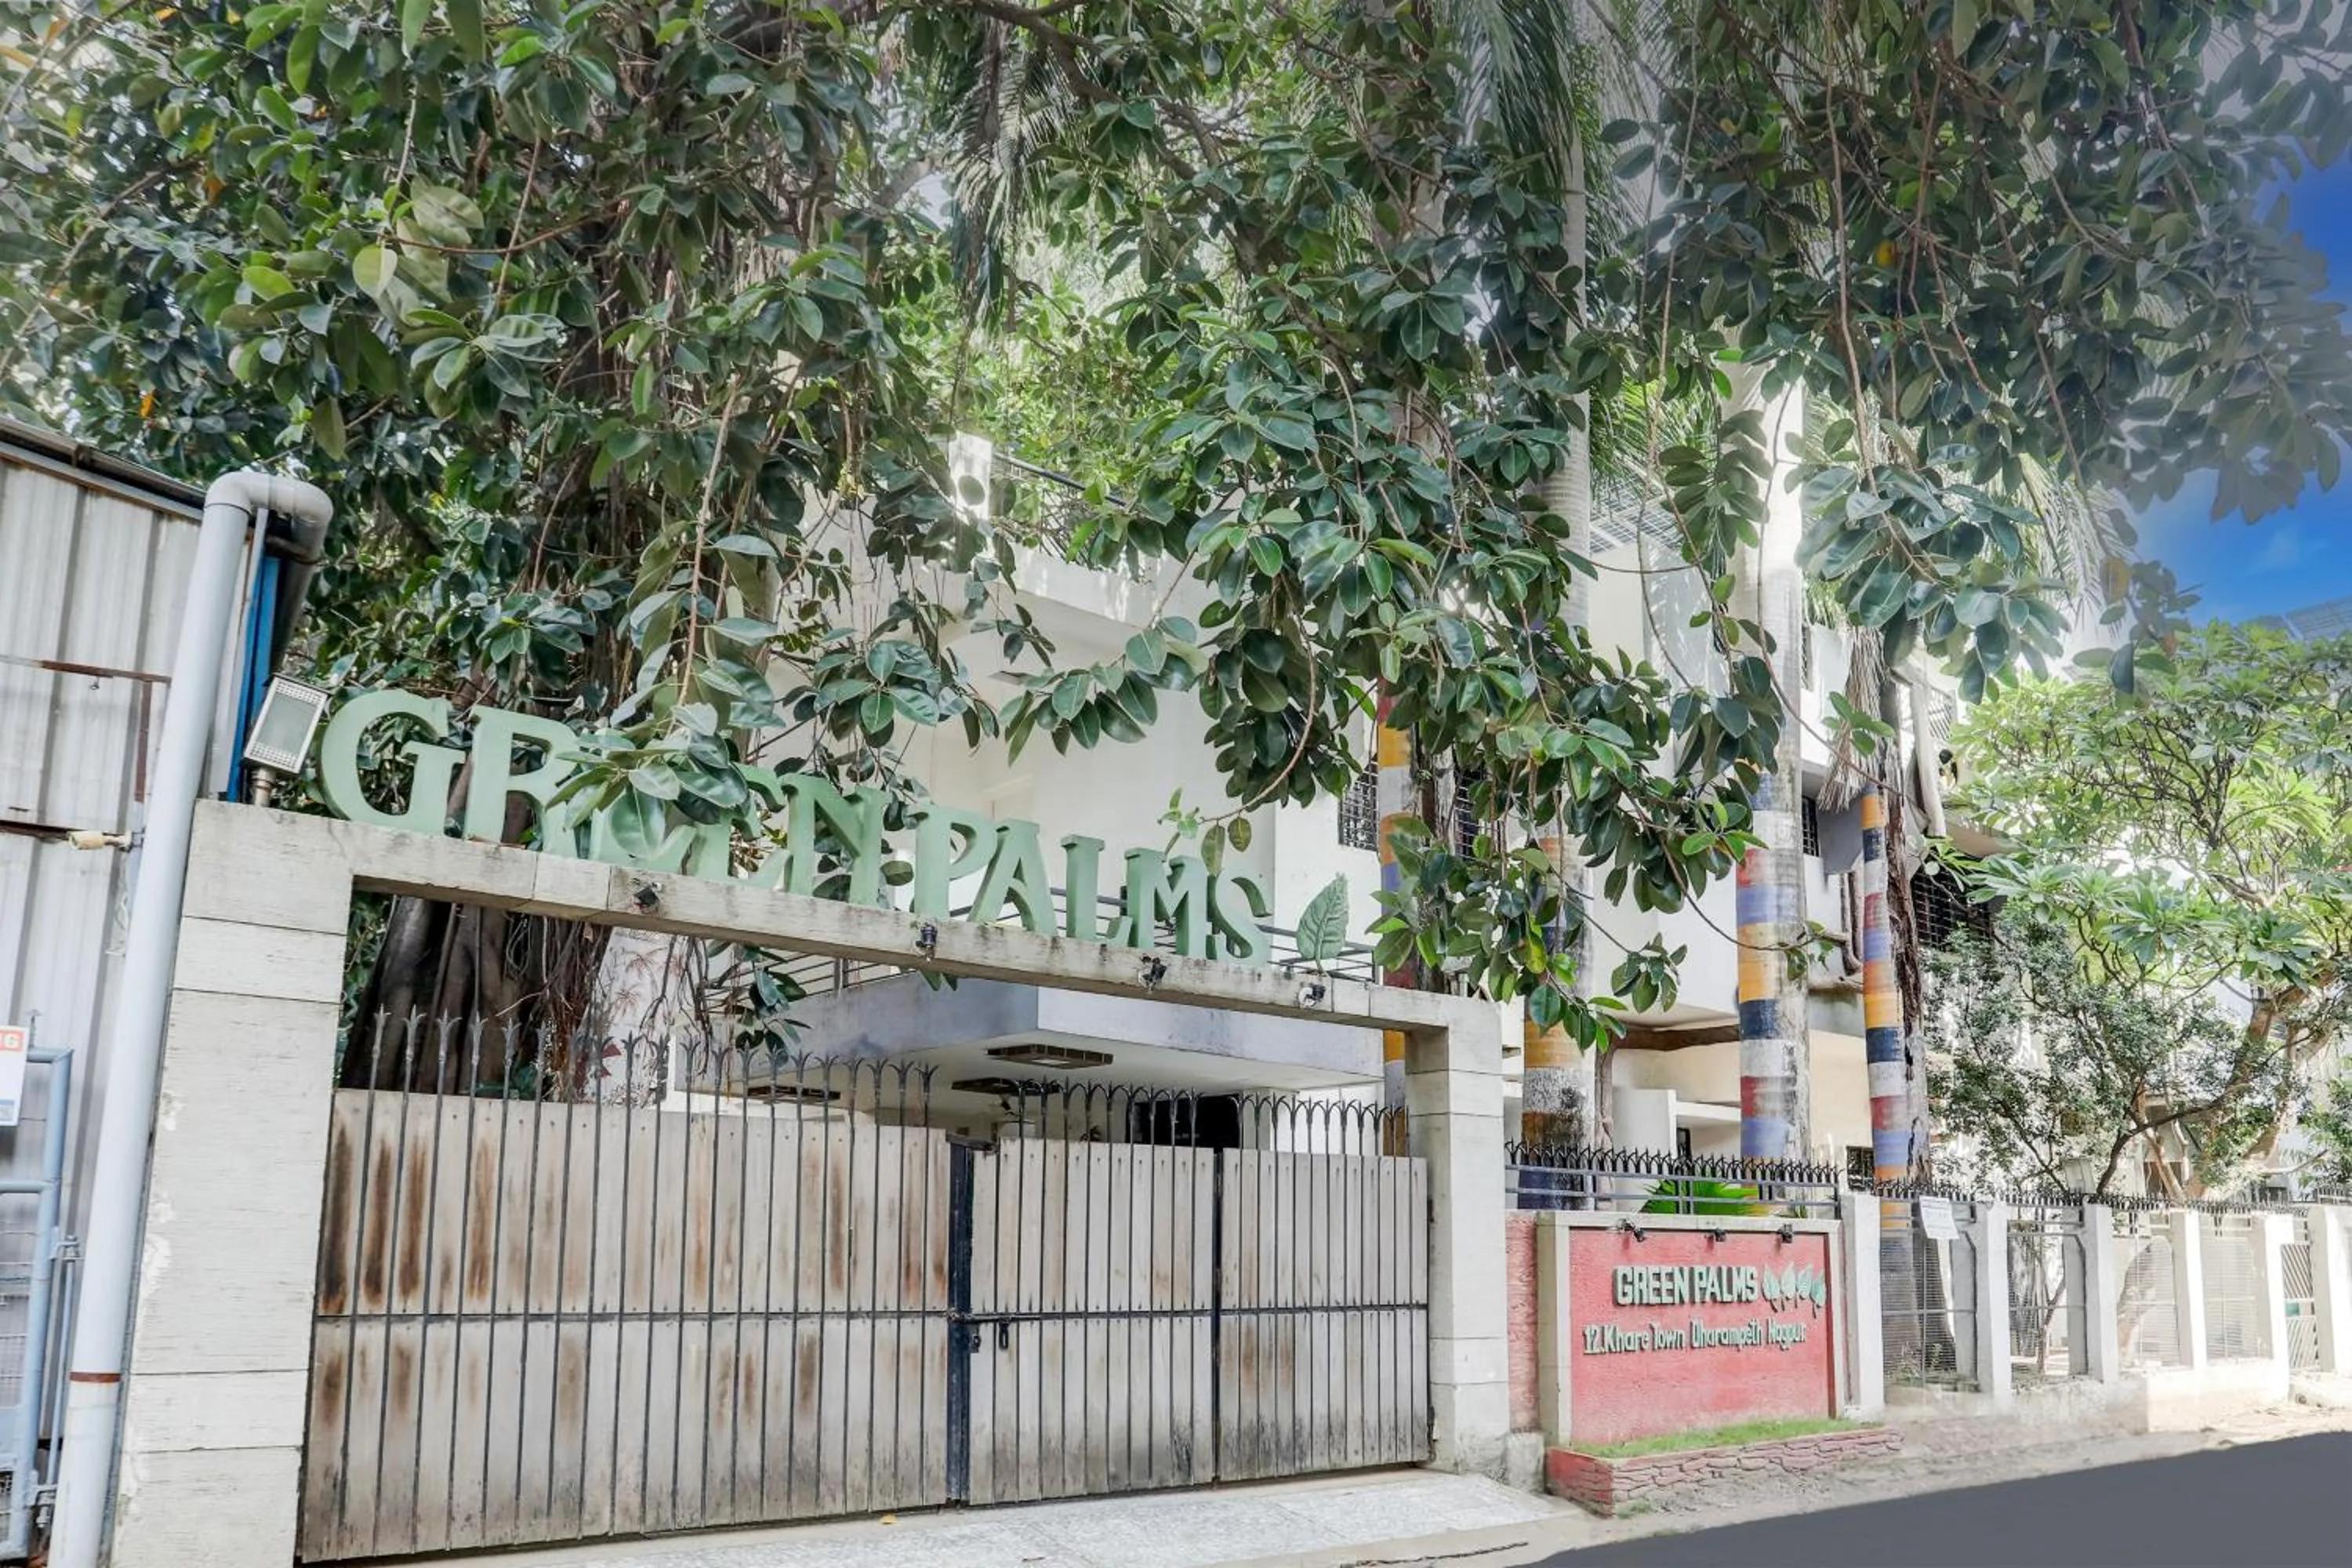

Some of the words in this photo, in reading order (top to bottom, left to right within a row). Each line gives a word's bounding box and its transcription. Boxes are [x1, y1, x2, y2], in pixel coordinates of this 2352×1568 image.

[908, 800, 1272, 966] PALMS
[1613, 1265, 1689, 1305] GREEN
[1691, 1265, 1758, 1303] PALMS
[1650, 1322, 1684, 1350] Town
